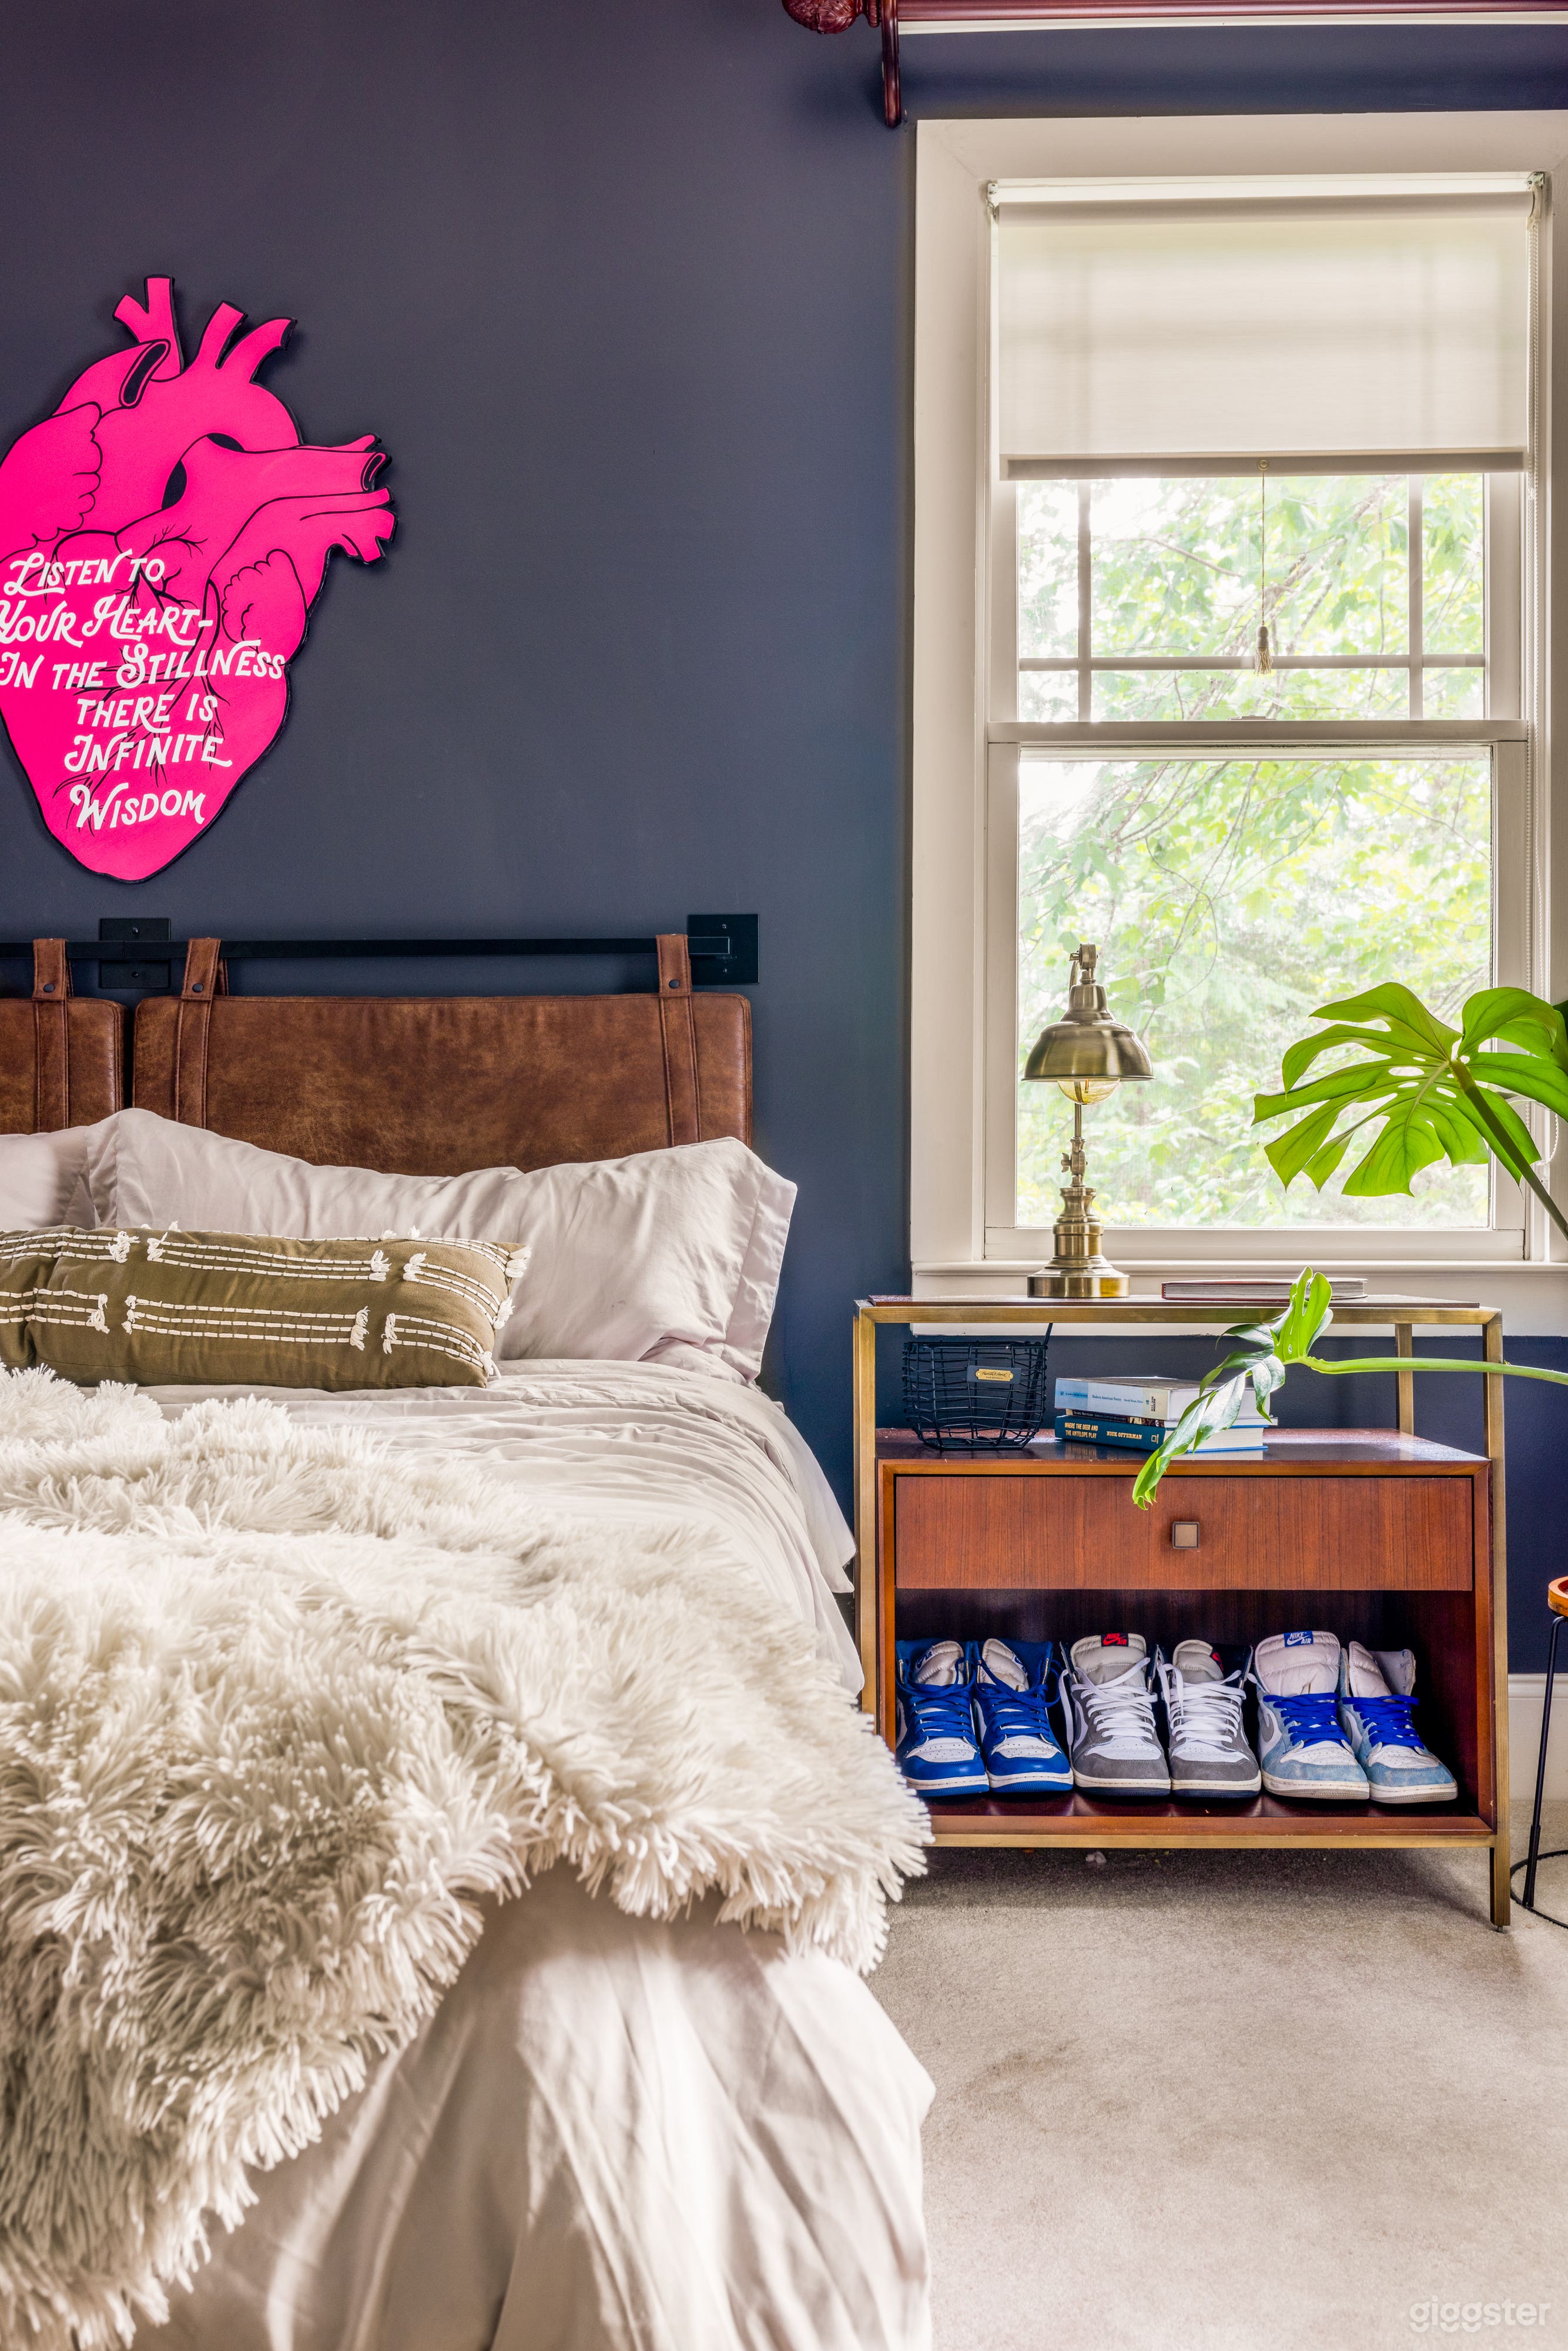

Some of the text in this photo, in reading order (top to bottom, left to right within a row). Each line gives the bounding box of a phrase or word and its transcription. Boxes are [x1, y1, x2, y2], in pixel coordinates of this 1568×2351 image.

[129, 558, 165, 582] TO
[0, 600, 83, 648] YOUR
[52, 661, 108, 690] THE
[116, 639, 286, 689] STILLNESS
[77, 694, 218, 734] THERE IS
[64, 732, 233, 772] INFINITE
[69, 782, 206, 830] WISDOM
[1118, 1432, 1143, 1440] OFFERMAN
[1289, 1632, 1305, 1640] NIKE
